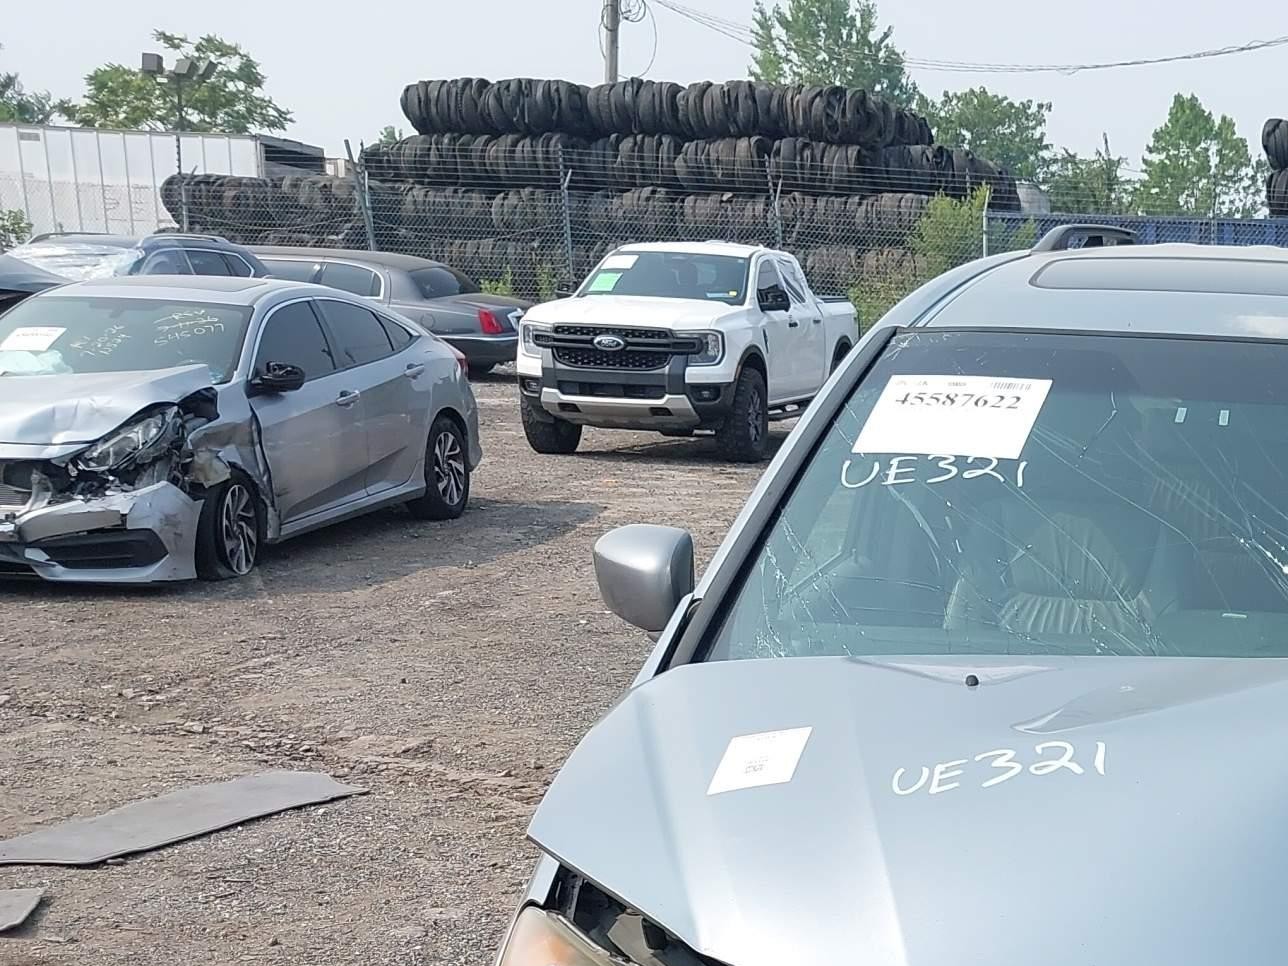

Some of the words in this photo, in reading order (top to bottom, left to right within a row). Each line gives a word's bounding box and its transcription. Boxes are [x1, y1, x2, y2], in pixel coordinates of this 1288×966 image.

[895, 392, 1023, 410] 45587622
[840, 453, 1029, 489] UE321
[891, 740, 1107, 796] UE321
